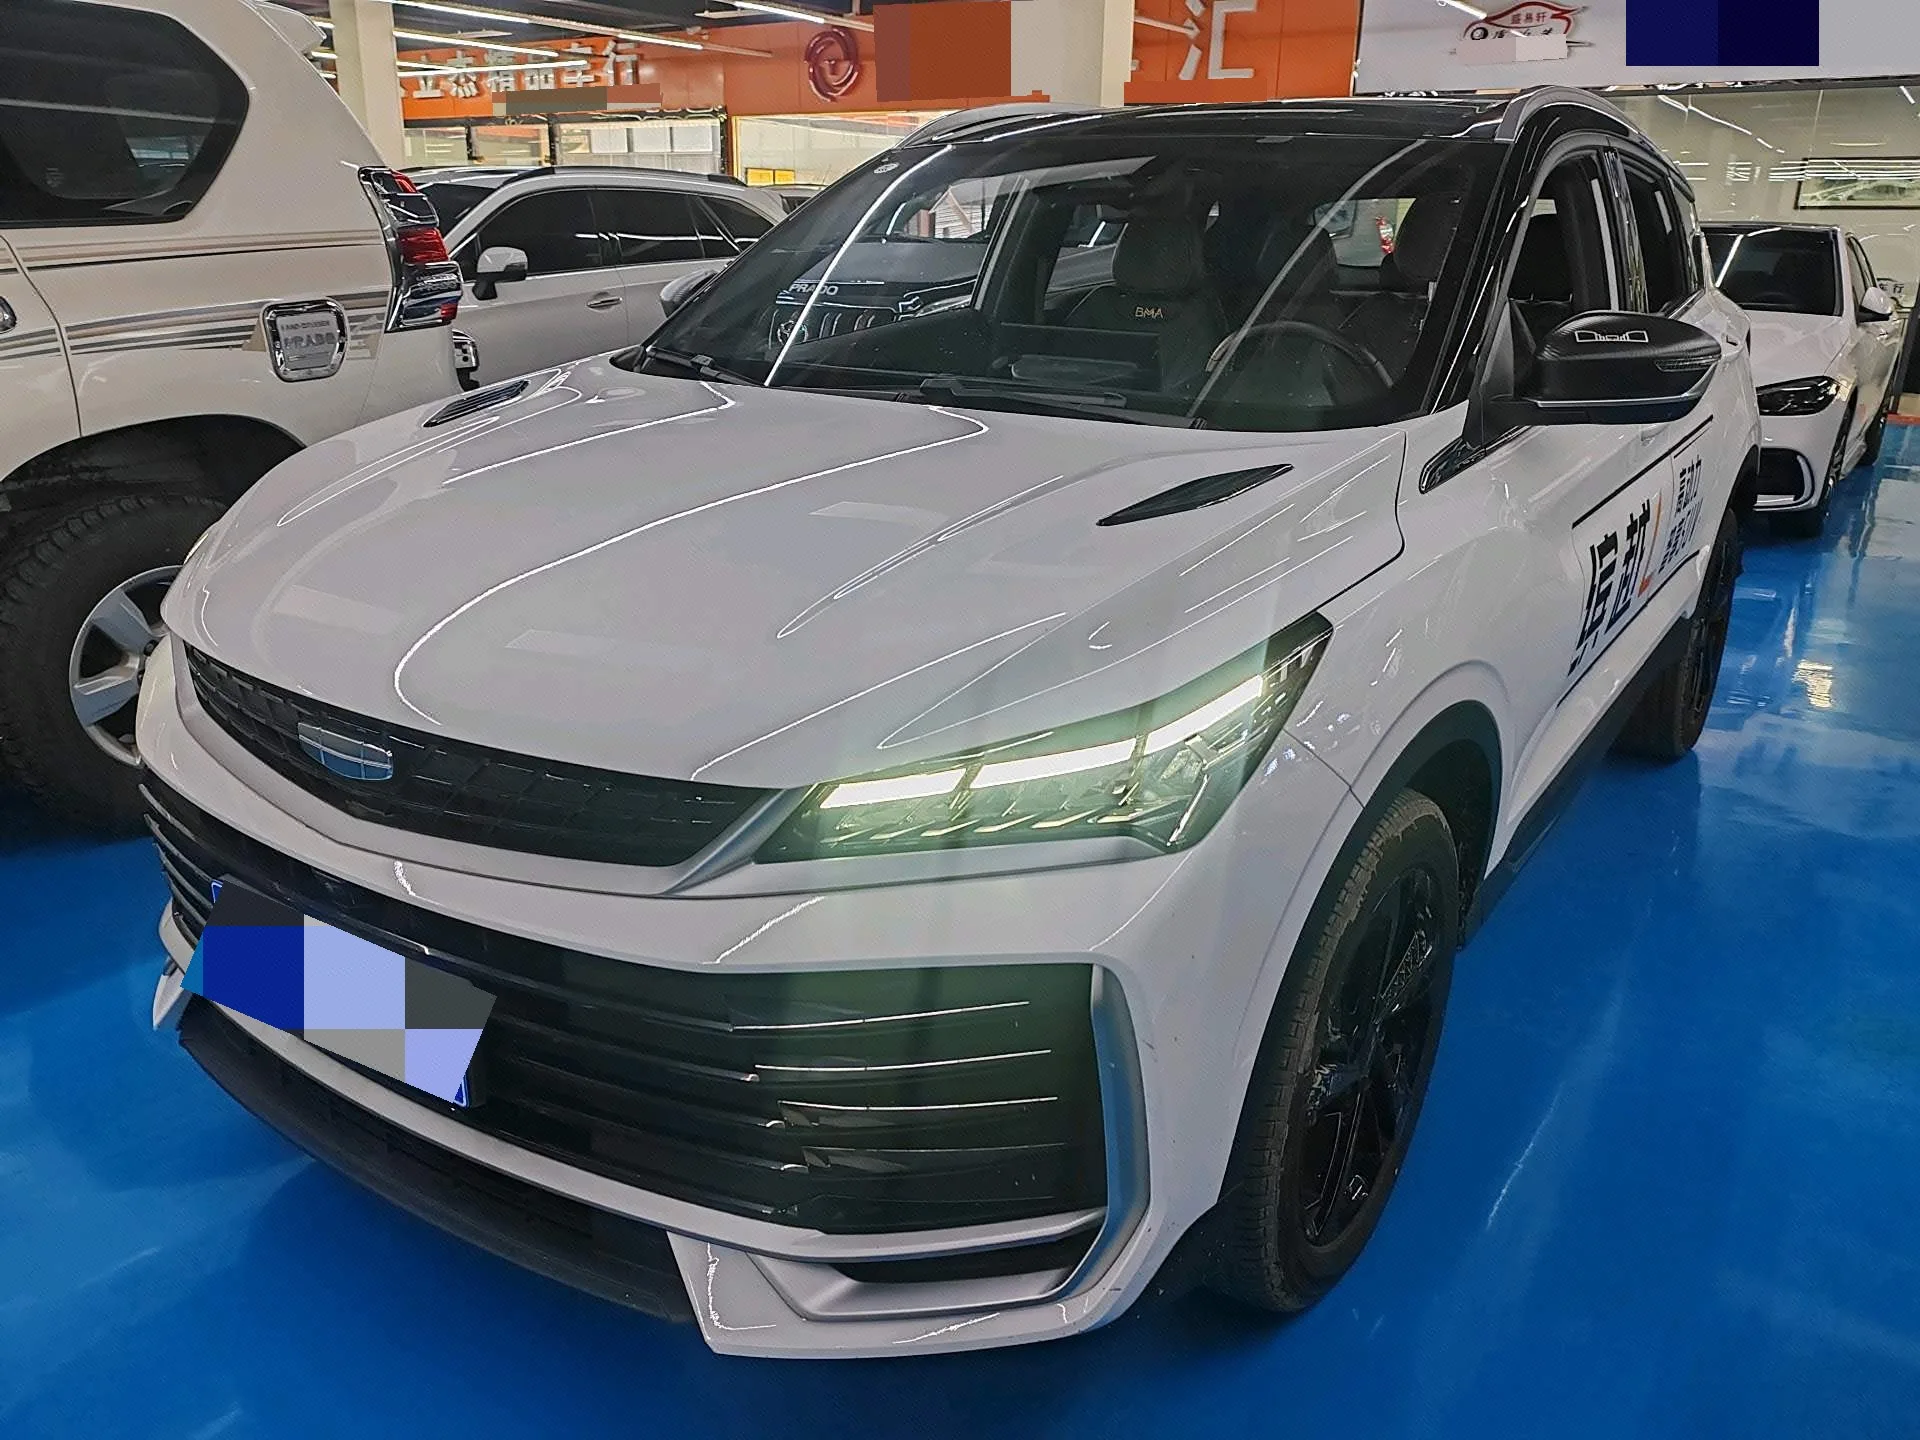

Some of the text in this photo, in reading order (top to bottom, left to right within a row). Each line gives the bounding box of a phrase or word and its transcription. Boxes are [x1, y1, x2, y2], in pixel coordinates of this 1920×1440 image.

[401, 39, 638, 98] 立杰精品车行
